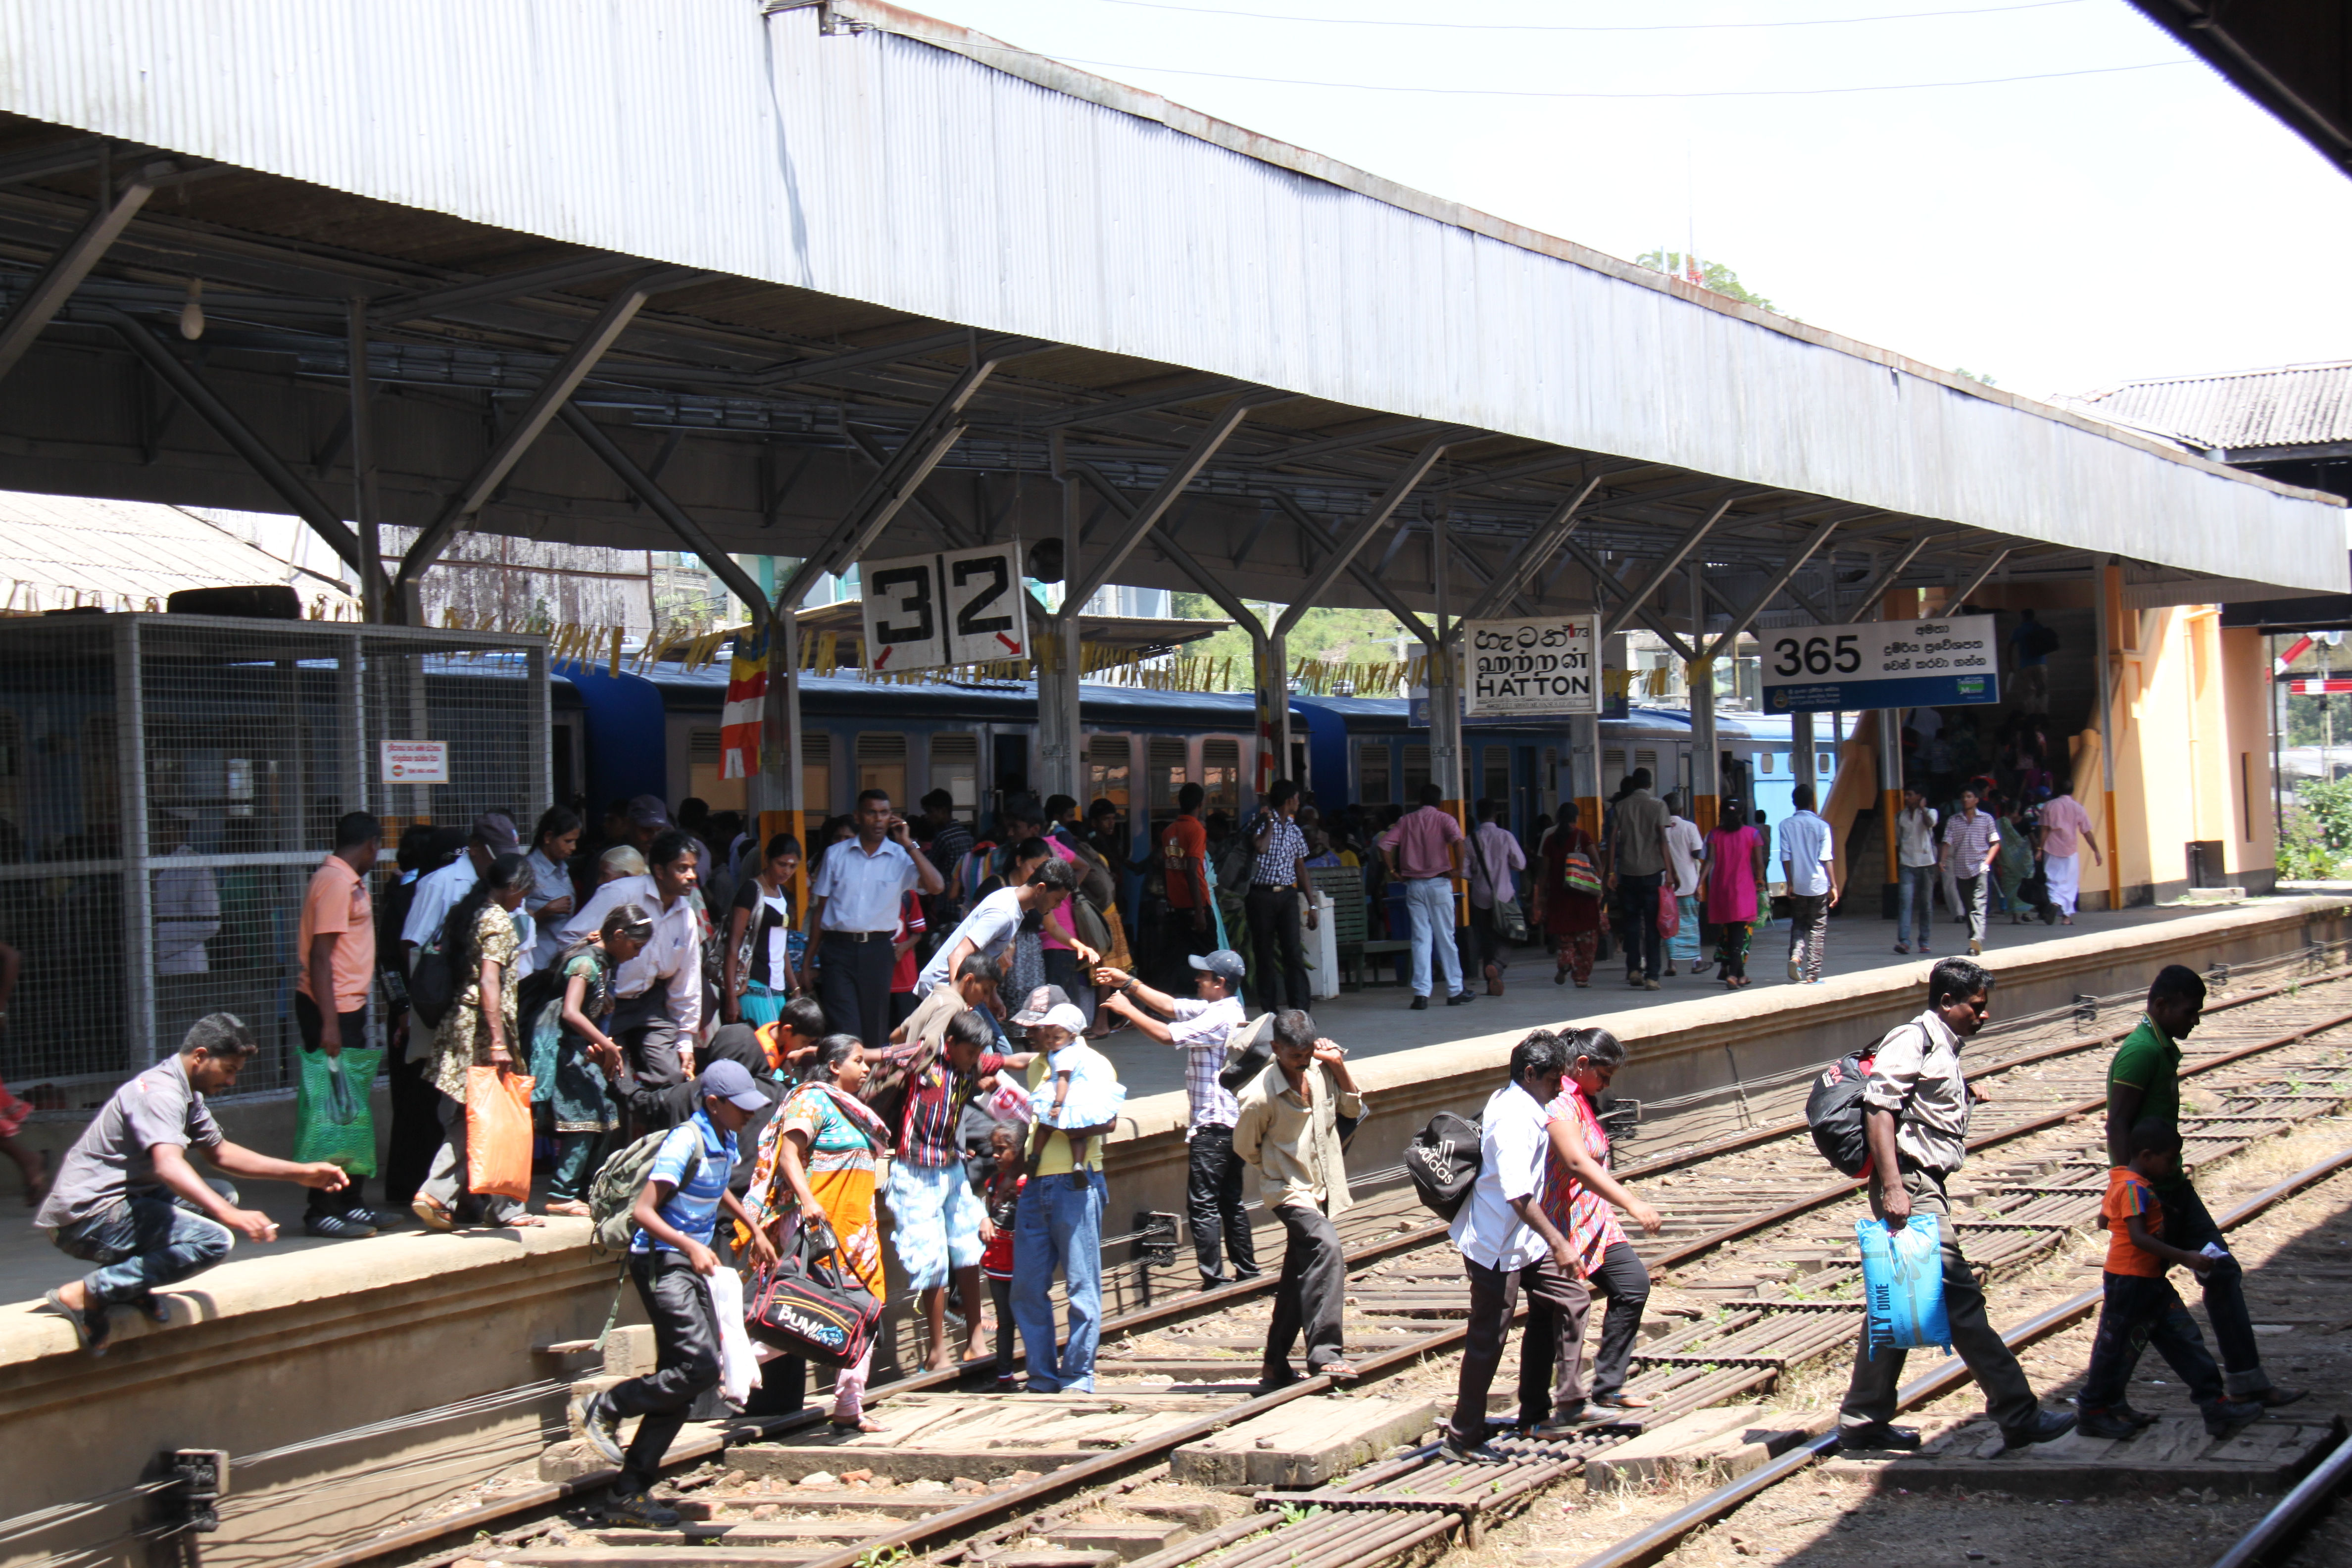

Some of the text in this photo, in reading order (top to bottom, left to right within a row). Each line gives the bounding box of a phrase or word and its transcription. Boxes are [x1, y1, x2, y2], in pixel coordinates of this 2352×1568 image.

[872, 555, 1013, 644] 3 2
[1477, 647, 1590, 679] ஹற்றன்
[1774, 635, 1862, 677] 365
[1476, 676, 1590, 697] HATTON
[1418, 1147, 1454, 1184] adidas
[778, 1308, 824, 1335] PUMA
[1870, 1283, 1896, 1345] OLY DIME
[807, 1332, 822, 1342] DEN
